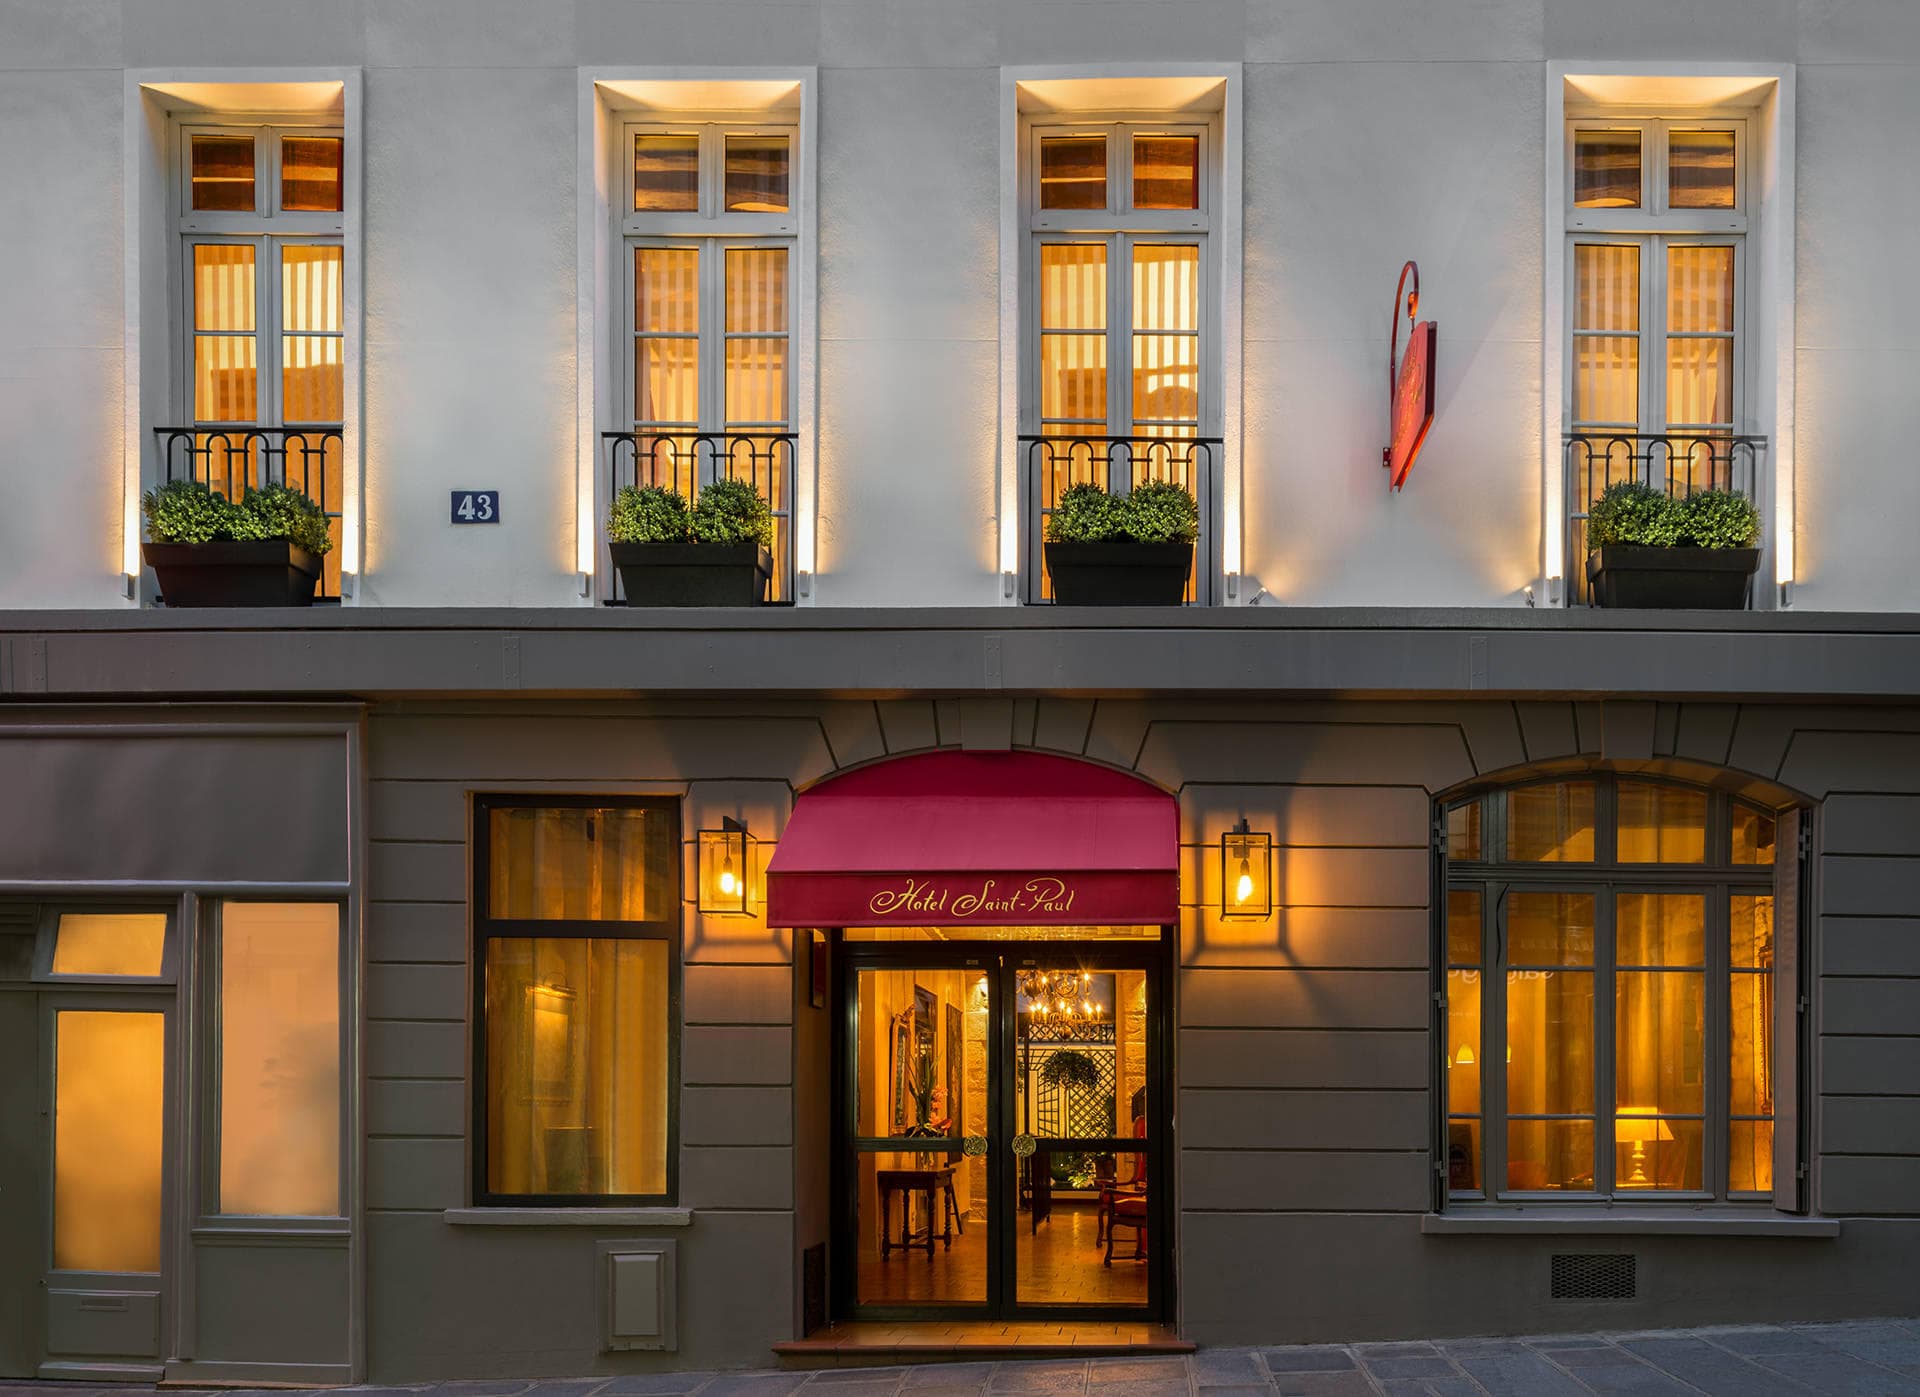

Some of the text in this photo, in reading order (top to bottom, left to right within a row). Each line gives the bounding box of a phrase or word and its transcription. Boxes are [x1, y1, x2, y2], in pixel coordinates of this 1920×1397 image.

[457, 494, 493, 520] 43
[869, 877, 1075, 917] Hotel Saint-Paul
